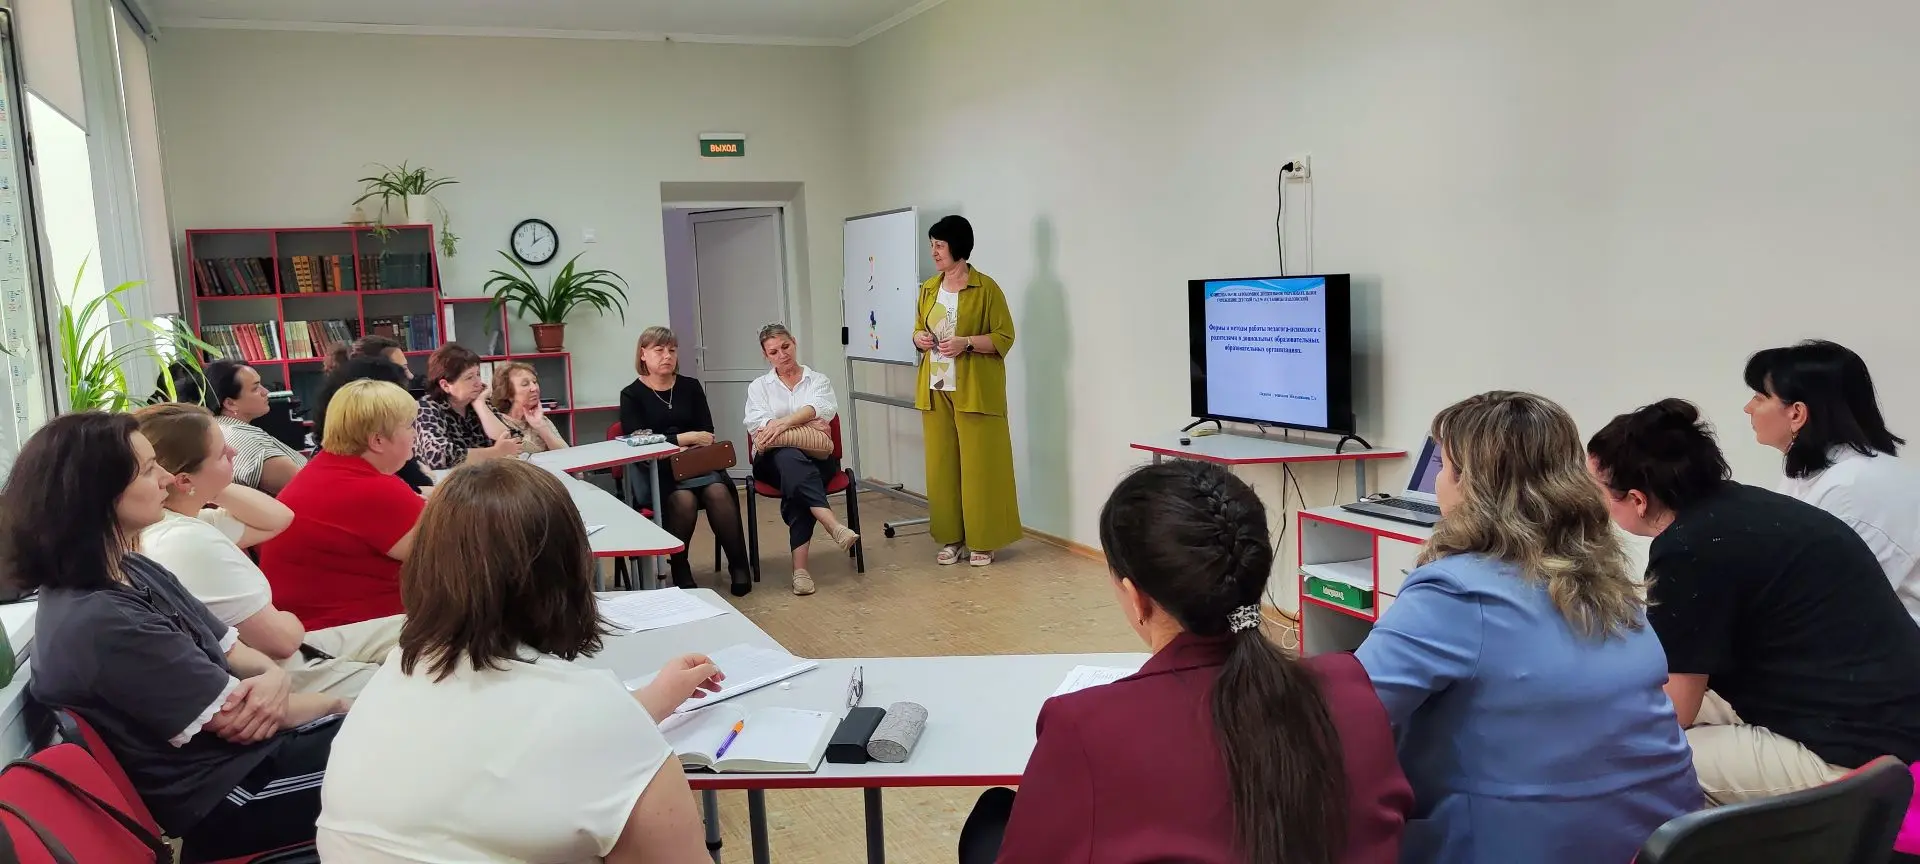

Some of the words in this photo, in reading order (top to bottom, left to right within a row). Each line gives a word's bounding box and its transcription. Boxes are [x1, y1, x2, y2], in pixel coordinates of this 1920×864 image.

[710, 144, 737, 152] ВЫХОД
[1208, 324, 1226, 333] Формы
[1248, 324, 1266, 333] работы
